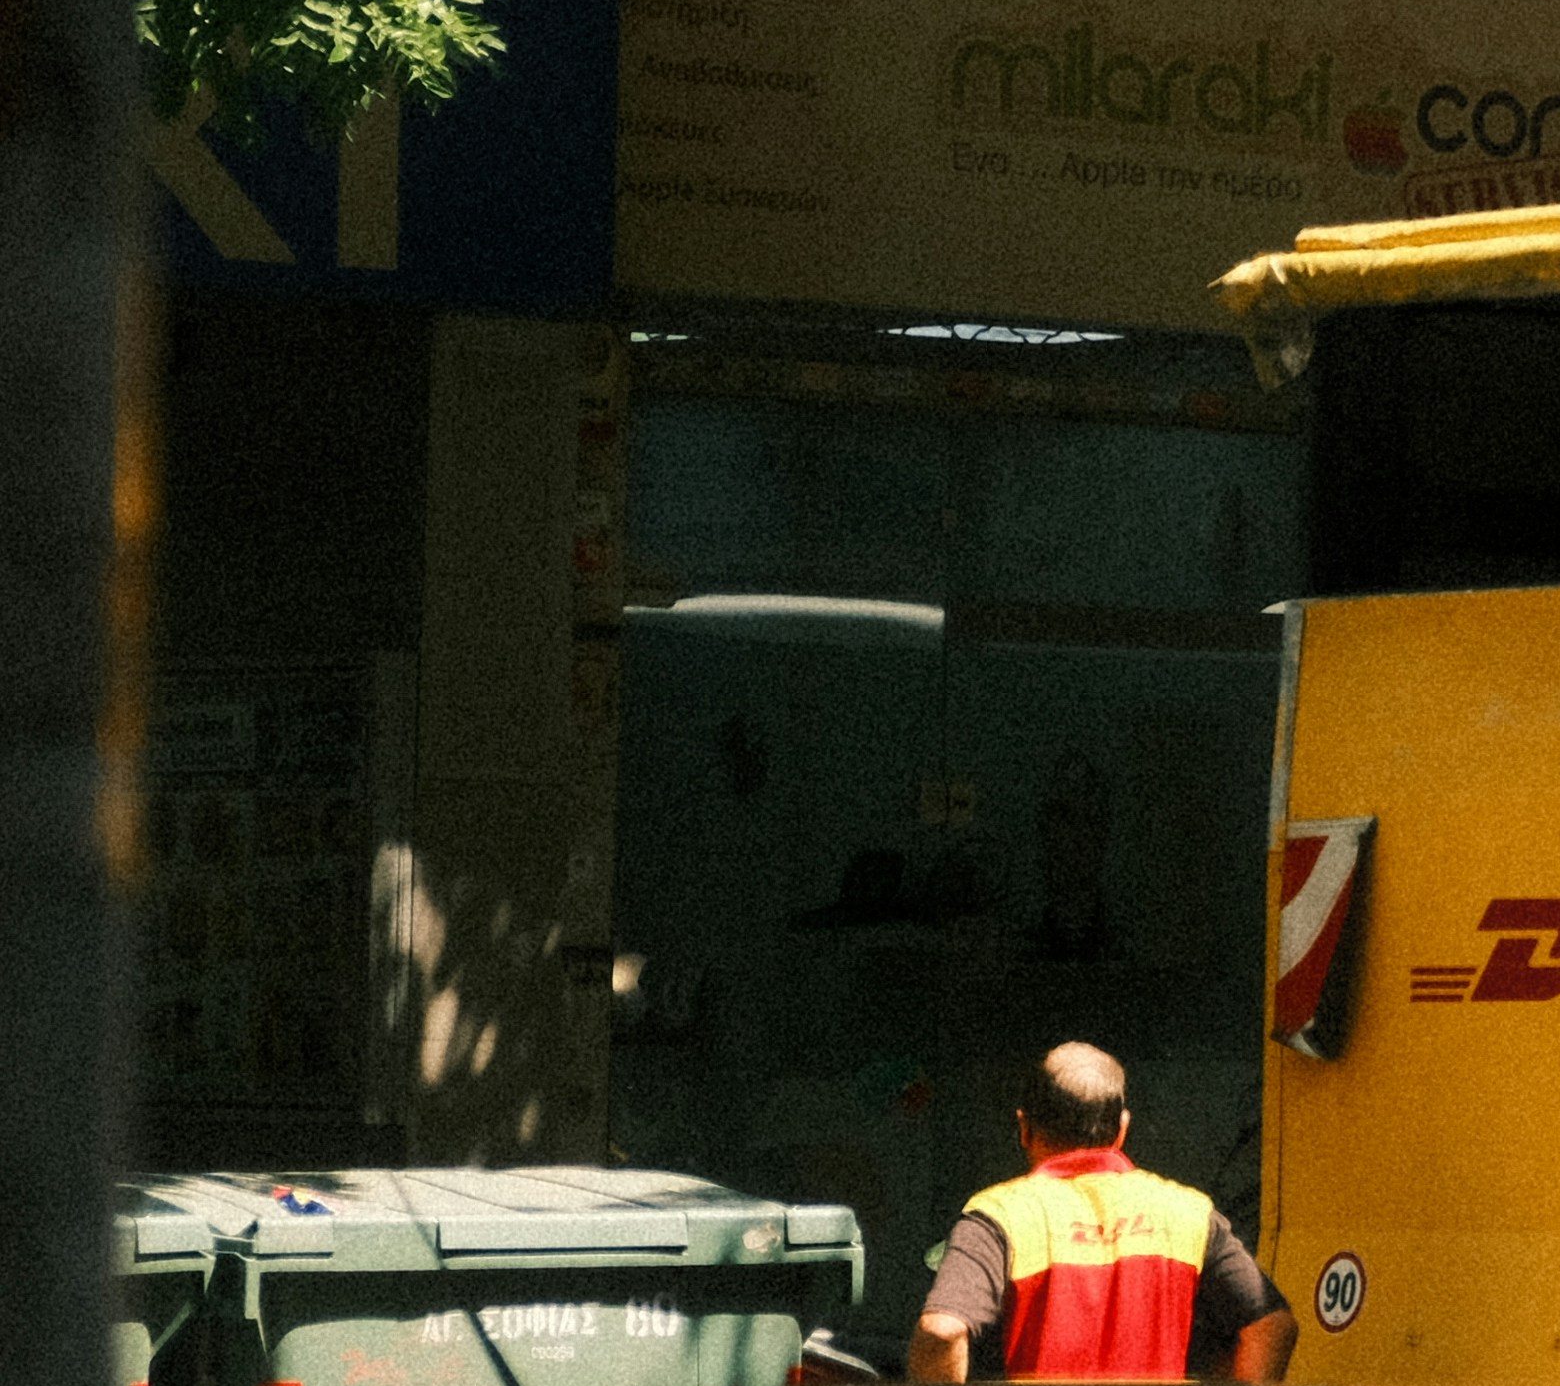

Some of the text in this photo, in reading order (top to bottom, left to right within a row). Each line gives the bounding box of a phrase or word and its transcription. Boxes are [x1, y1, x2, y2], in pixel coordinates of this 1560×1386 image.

[951, 22, 1333, 143] milaraki
[1061, 152, 1146, 188] Apple
[1323, 1271, 1357, 1313] 90
